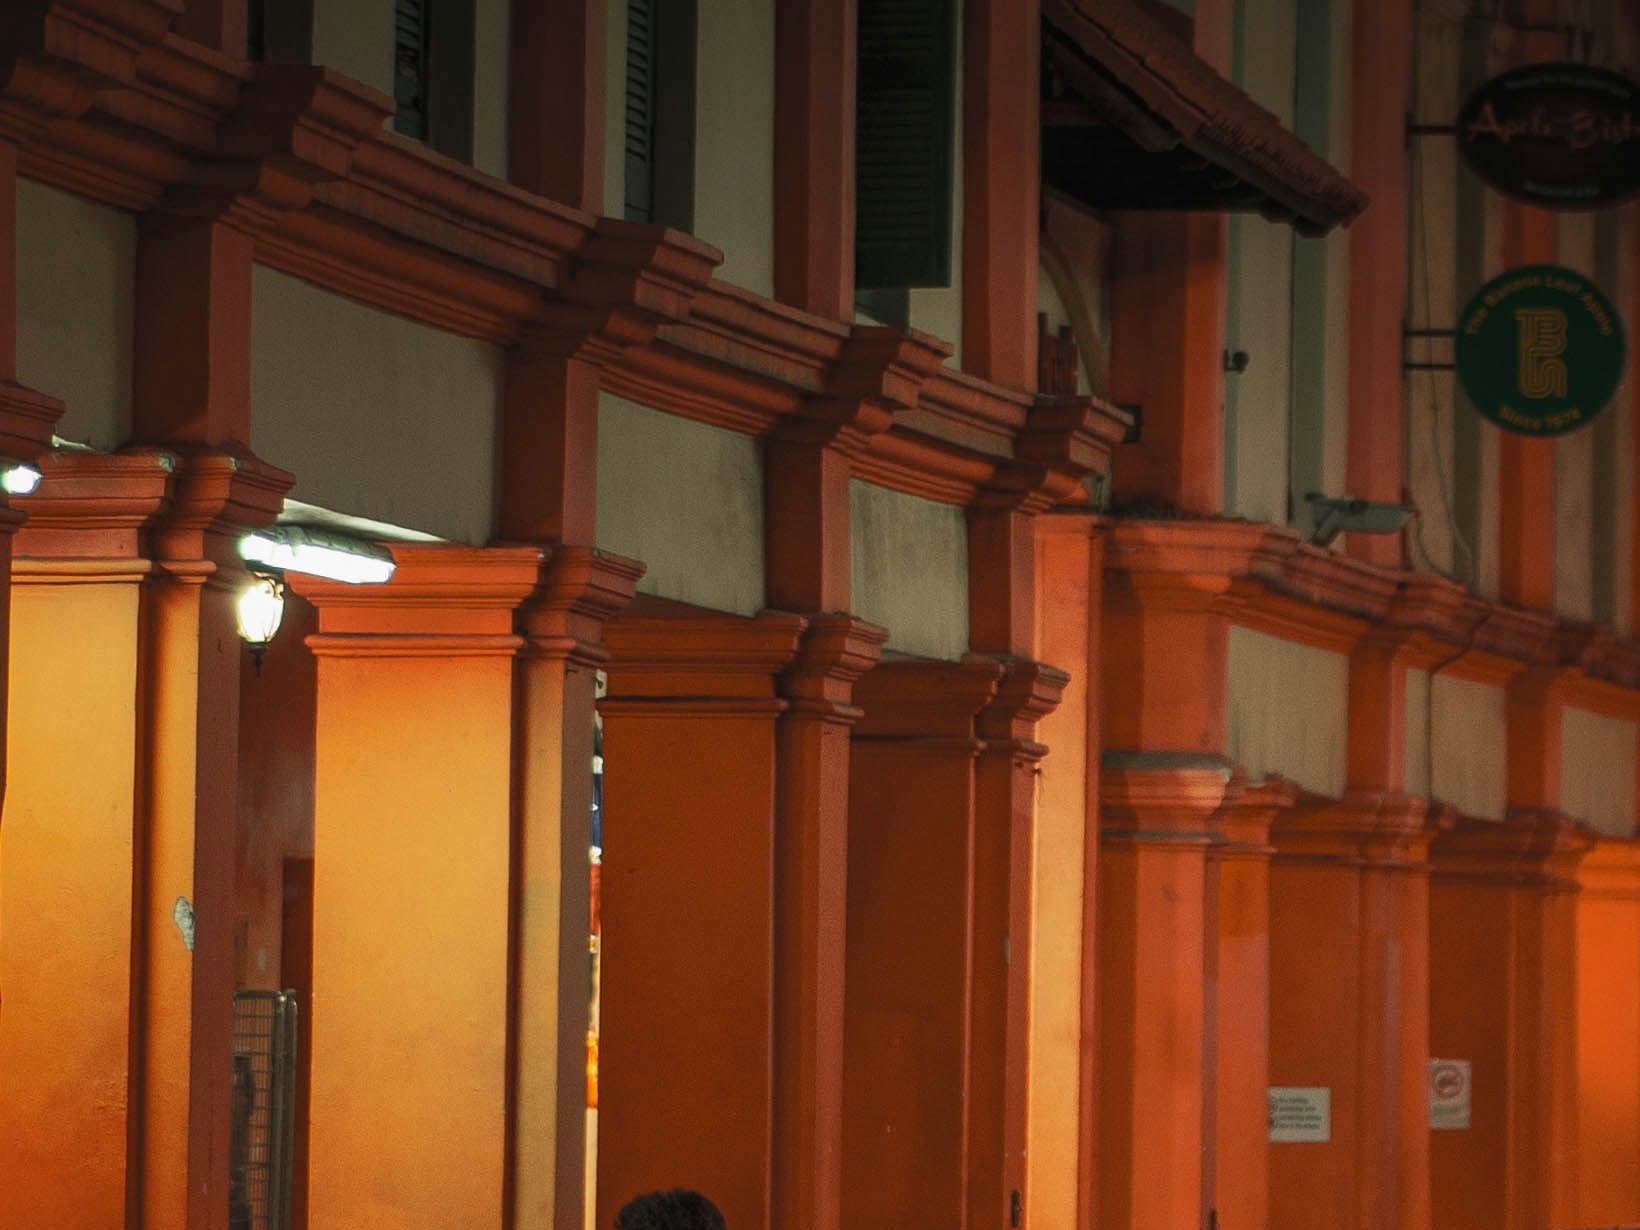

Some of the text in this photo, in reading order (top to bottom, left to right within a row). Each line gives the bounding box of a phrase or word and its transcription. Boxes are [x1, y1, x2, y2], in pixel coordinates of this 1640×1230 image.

[1464, 306, 1489, 335] The
[1483, 275, 1542, 307] Banana
[1544, 275, 1583, 294] Leaf
